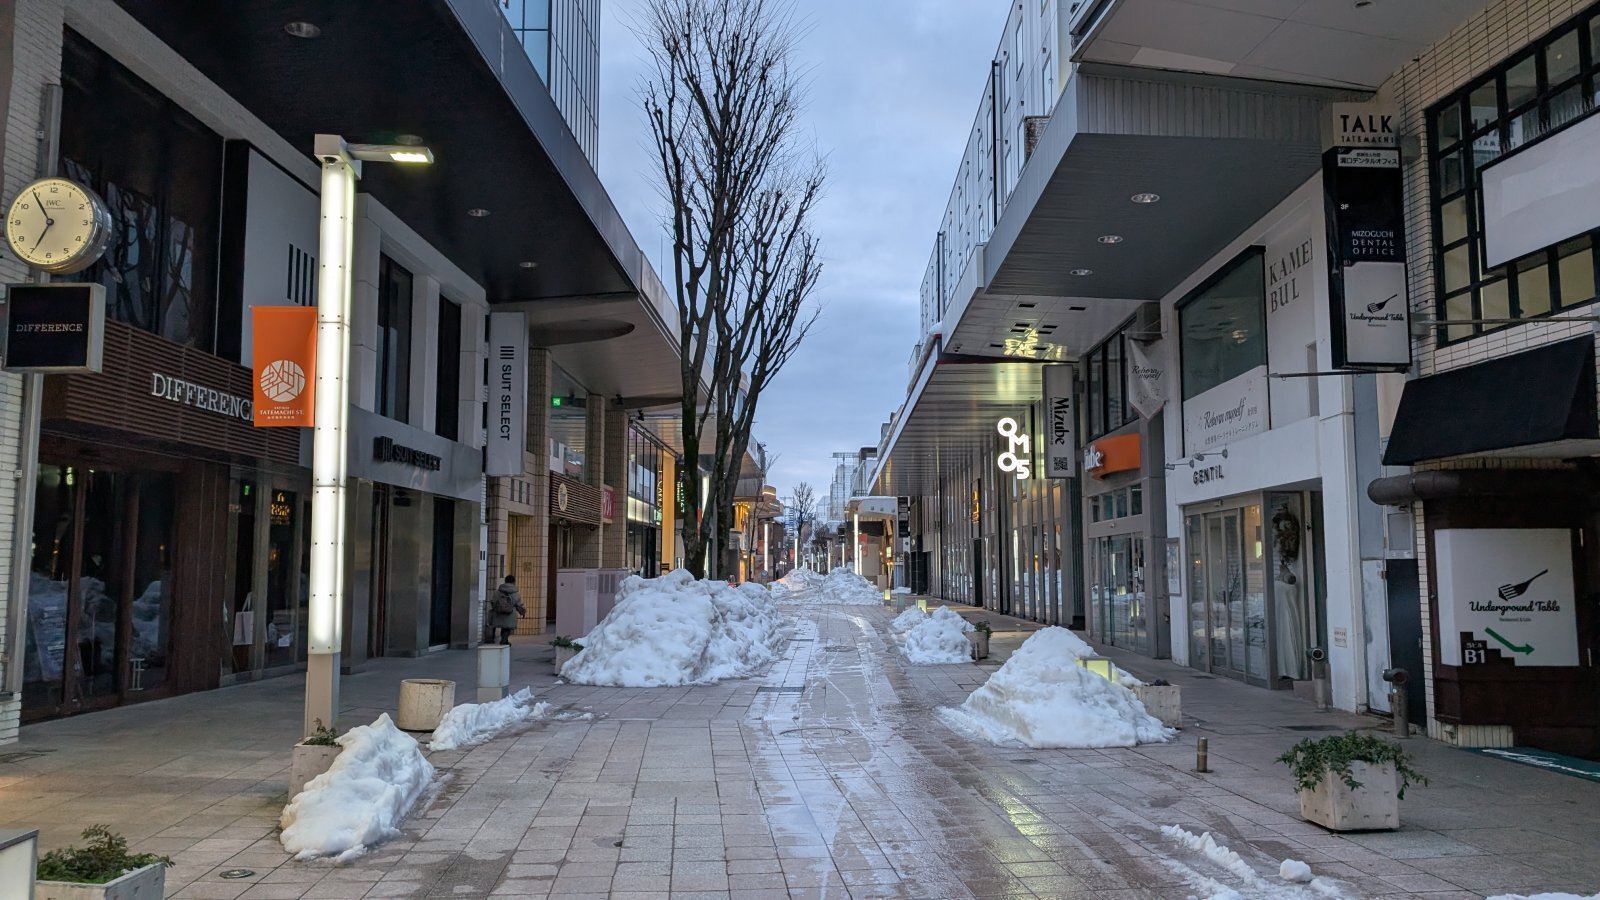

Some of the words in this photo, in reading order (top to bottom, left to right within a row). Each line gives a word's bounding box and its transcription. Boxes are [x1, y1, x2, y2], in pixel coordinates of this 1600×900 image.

[1340, 114, 1393, 133] TALK
[1341, 135, 1394, 143] TATEMACHI
[1351, 230, 1394, 238] MIZOGUCHI
[1352, 239, 1395, 247] DENTAL
[1352, 248, 1395, 256] OFFICE
[1350, 313, 1389, 323] Underground
[1390, 313, 1405, 321] Table
[15, 323, 83, 332] DIFFERENCE
[1131, 365, 1158, 374] Reborn
[501, 364, 512, 392] SUIT
[151, 372, 254, 421] DIFFERENC
[500, 394, 511, 441] SELECT
[1053, 397, 1070, 446] Mizube
[1203, 410, 1225, 430] Reborn
[1469, 600, 1534, 616] Underground
[1535, 600, 1560, 612] Table
[1464, 649, 1486, 664] B1
